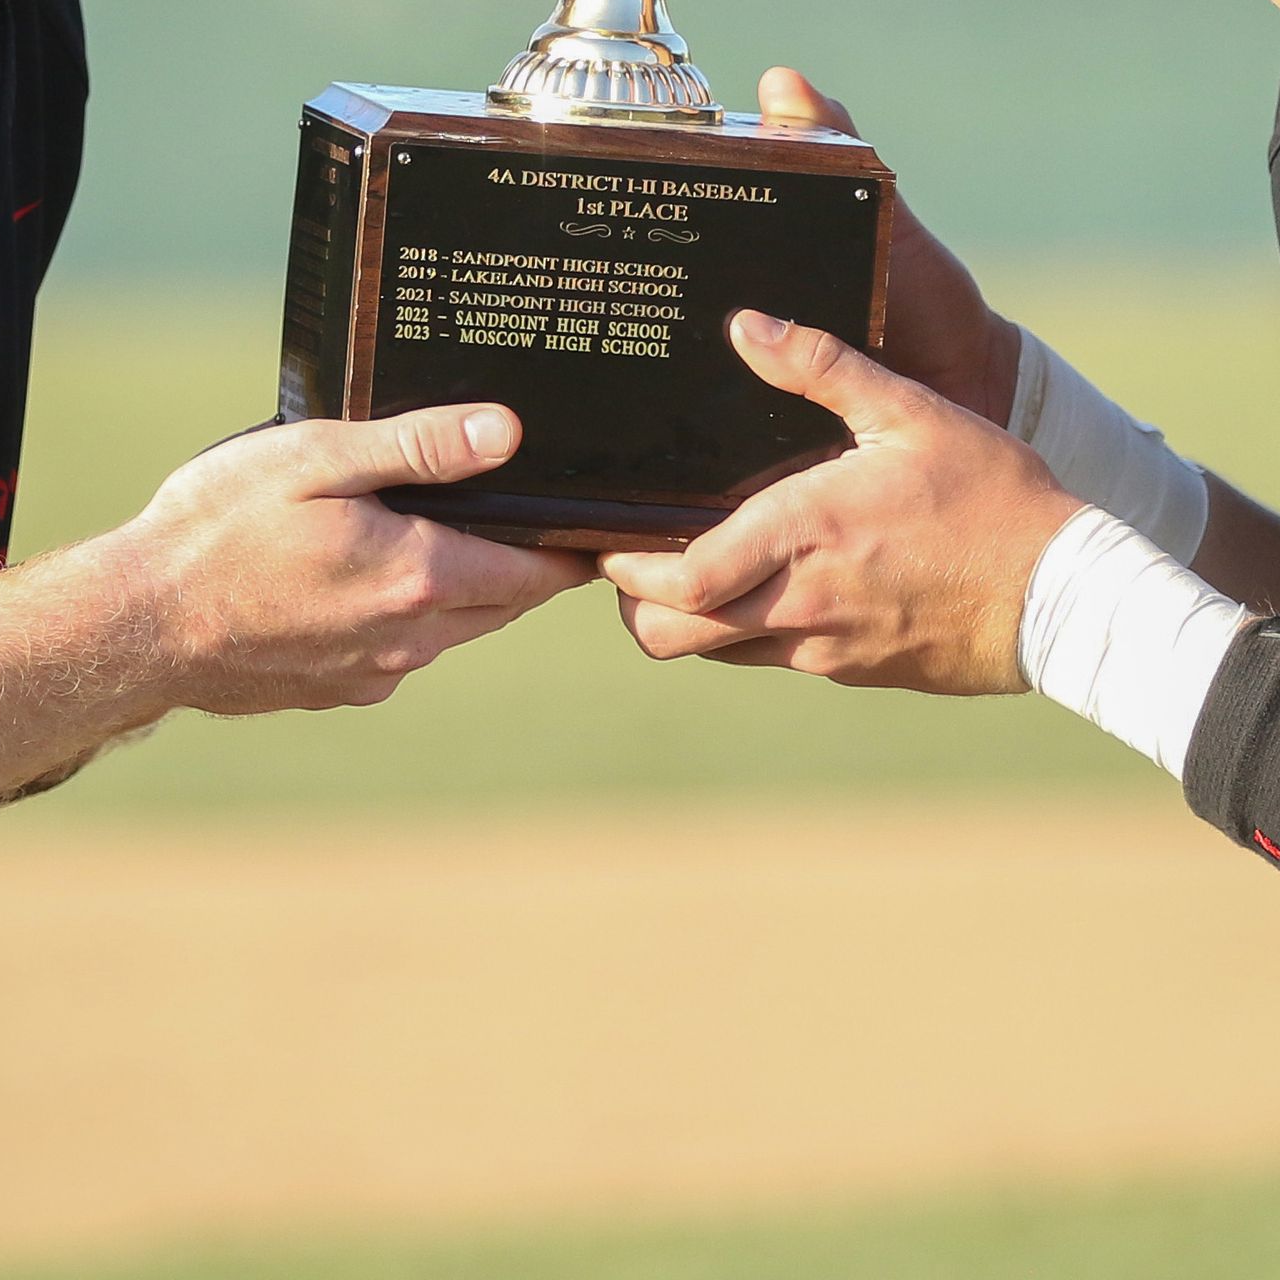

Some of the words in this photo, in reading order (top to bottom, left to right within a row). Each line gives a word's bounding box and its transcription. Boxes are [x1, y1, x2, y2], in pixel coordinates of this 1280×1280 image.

[487, 168, 516, 185] 4A
[521, 170, 622, 192] DISTRICT
[626, 177, 657, 195] I-II
[661, 180, 777, 203] BASEBALL
[576, 197, 605, 216] 1st
[608, 199, 689, 222] PLACE
[399, 246, 438, 262] 2018
[452, 250, 559, 270] SANDPOINT
[562, 258, 610, 274] HIGH
[613, 262, 689, 280] SCHOOL
[398, 265, 437, 280] 2019
[451, 269, 554, 288] LAKELAND
[557, 276, 605, 293] HIGH
[607, 280, 684, 298] SCHOOL
[395, 287, 433, 302] 2021
[449, 290, 556, 311] SANDPOINT
[558, 298, 606, 315] HIGH
[610, 302, 686, 321] SCHOOL
[395, 306, 430, 323] 2022
[455, 310, 550, 332] SANDPOINT
[556, 317, 600, 335] HIGH
[608, 321, 671, 341] SCHOOL
[394, 324, 430, 341] 2023
[459, 328, 537, 349] MOSCOW
[545, 334, 592, 353] HIGH
[601, 339, 670, 359] SCHOOL
